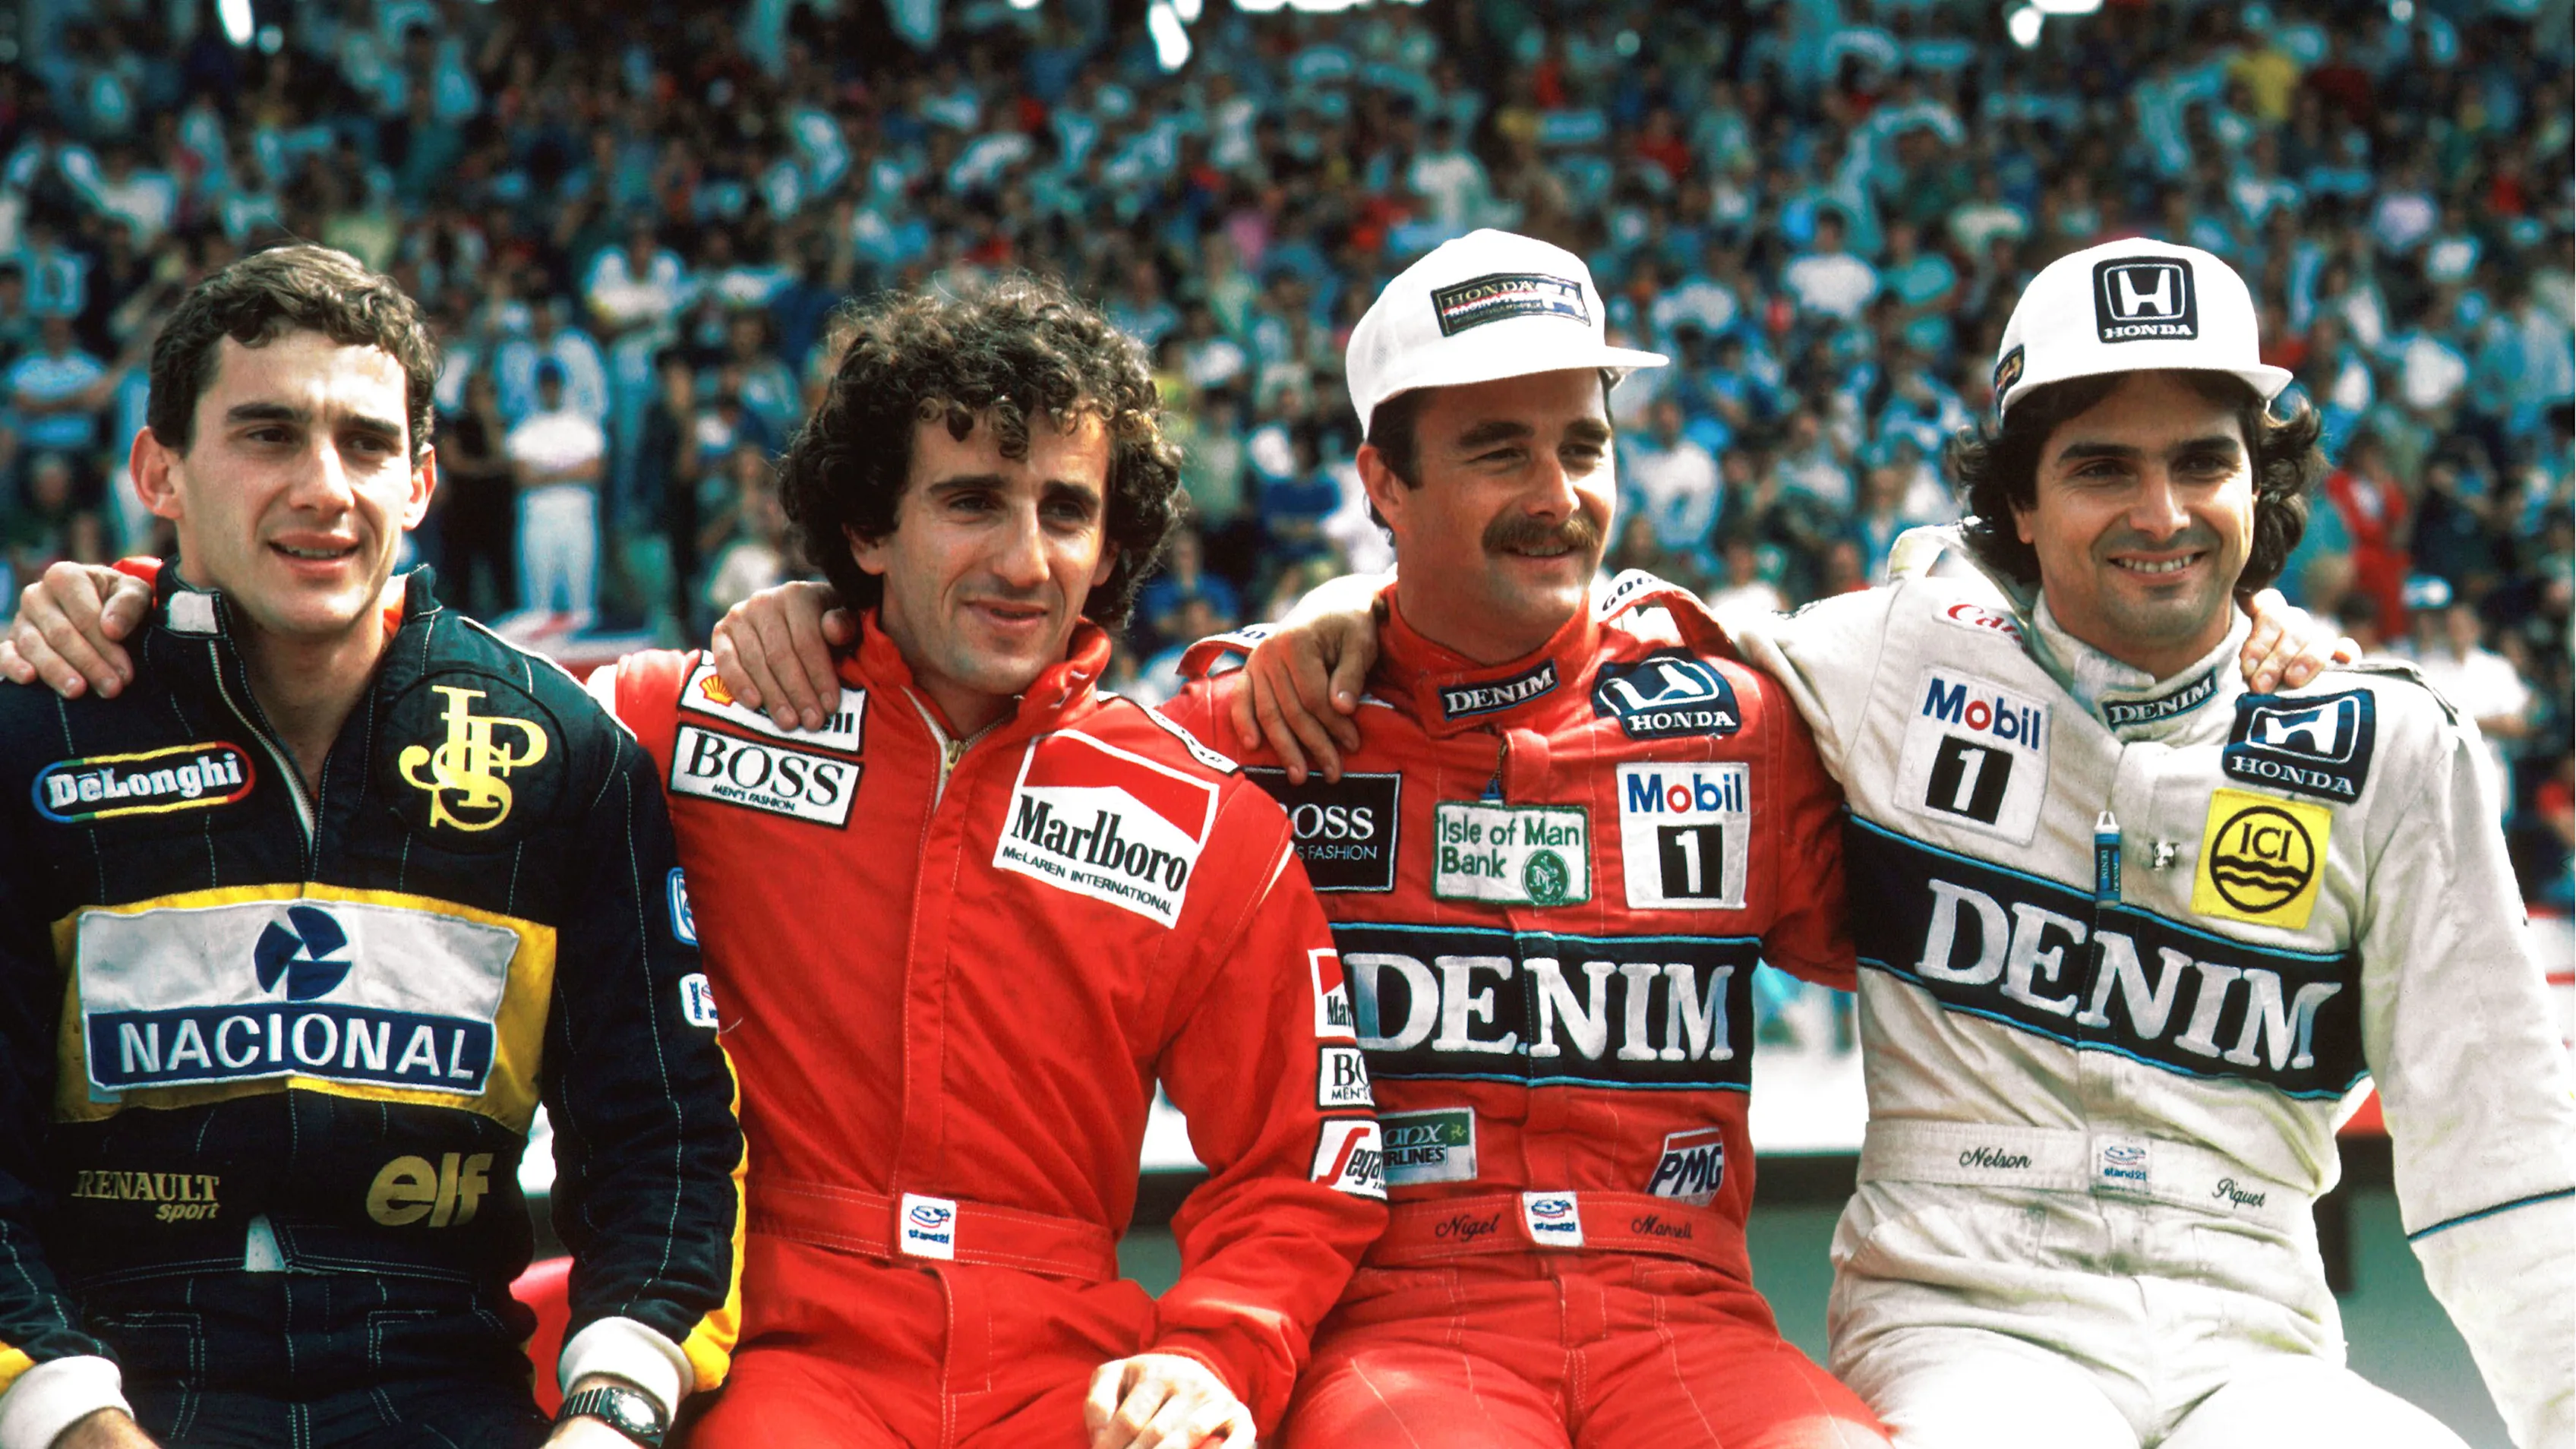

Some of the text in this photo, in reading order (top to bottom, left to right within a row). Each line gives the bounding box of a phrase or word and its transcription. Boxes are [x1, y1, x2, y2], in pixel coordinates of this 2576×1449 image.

[1445, 280, 1537, 306] HONDA
[2104, 324, 2193, 339] HONDA
[1444, 668, 1555, 713] DENIM
[2109, 677, 2212, 724] DENIM
[1627, 710, 1736, 731] HONDA
[1922, 677, 2041, 750] Mobil
[684, 732, 844, 807] BOSS
[1953, 748, 1987, 812] 1
[2232, 756, 2355, 796] HONDA
[711, 784, 796, 812] MEN'S FASHION
[1627, 773, 1744, 813] Mobil
[1279, 803, 1375, 841] OSS
[1441, 814, 1580, 847] Isle of Man
[1010, 794, 1188, 892] Marlboro
[1308, 844, 1378, 860] FASHION
[1441, 845, 1507, 879] Bank
[1676, 829, 1702, 894] 1
[2240, 822, 2293, 863] ICI
[1002, 846, 1173, 916] McLAREN INTERNATIONAL
[1915, 878, 2342, 1070] DENIM
[1343, 952, 1735, 1061] DENIM
[118, 1012, 474, 1079] NACIONAL
[1645, 1145, 1723, 1195] PMG
[1959, 1146, 2032, 1170] Nelson
[71, 1170, 220, 1202] RENAULT
[365, 1152, 494, 1228] elf
[2211, 1178, 2267, 1209] Piquet
[154, 1200, 222, 1224] sport
[1435, 1213, 1501, 1242] Nigel
